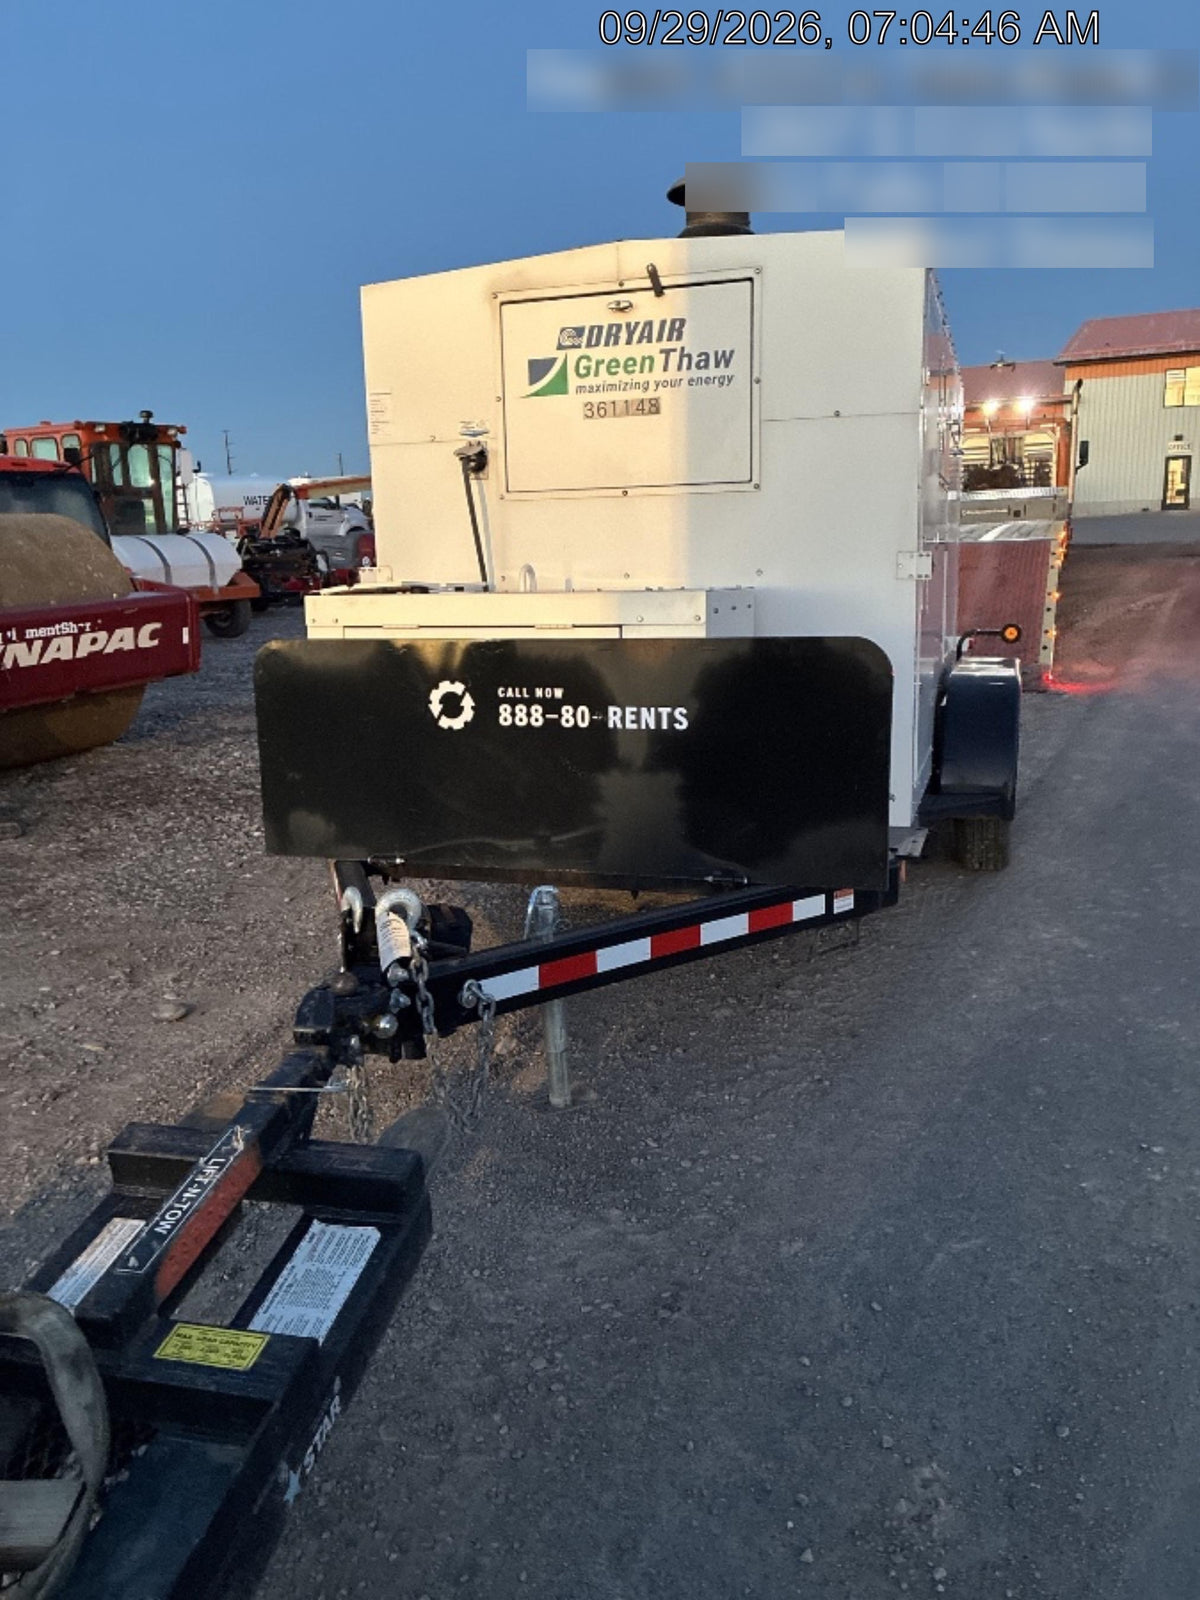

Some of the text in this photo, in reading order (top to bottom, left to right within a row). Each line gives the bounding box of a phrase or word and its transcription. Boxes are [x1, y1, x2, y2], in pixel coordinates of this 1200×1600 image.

[585, 317, 686, 349] DRYAIR
[575, 373, 735, 395] maximizing your energy
[584, 398, 661, 419] 361148
[243, 495, 272, 506] WATE
[0, 622, 162, 670] NAPAC
[498, 687, 564, 699] CALL NOW
